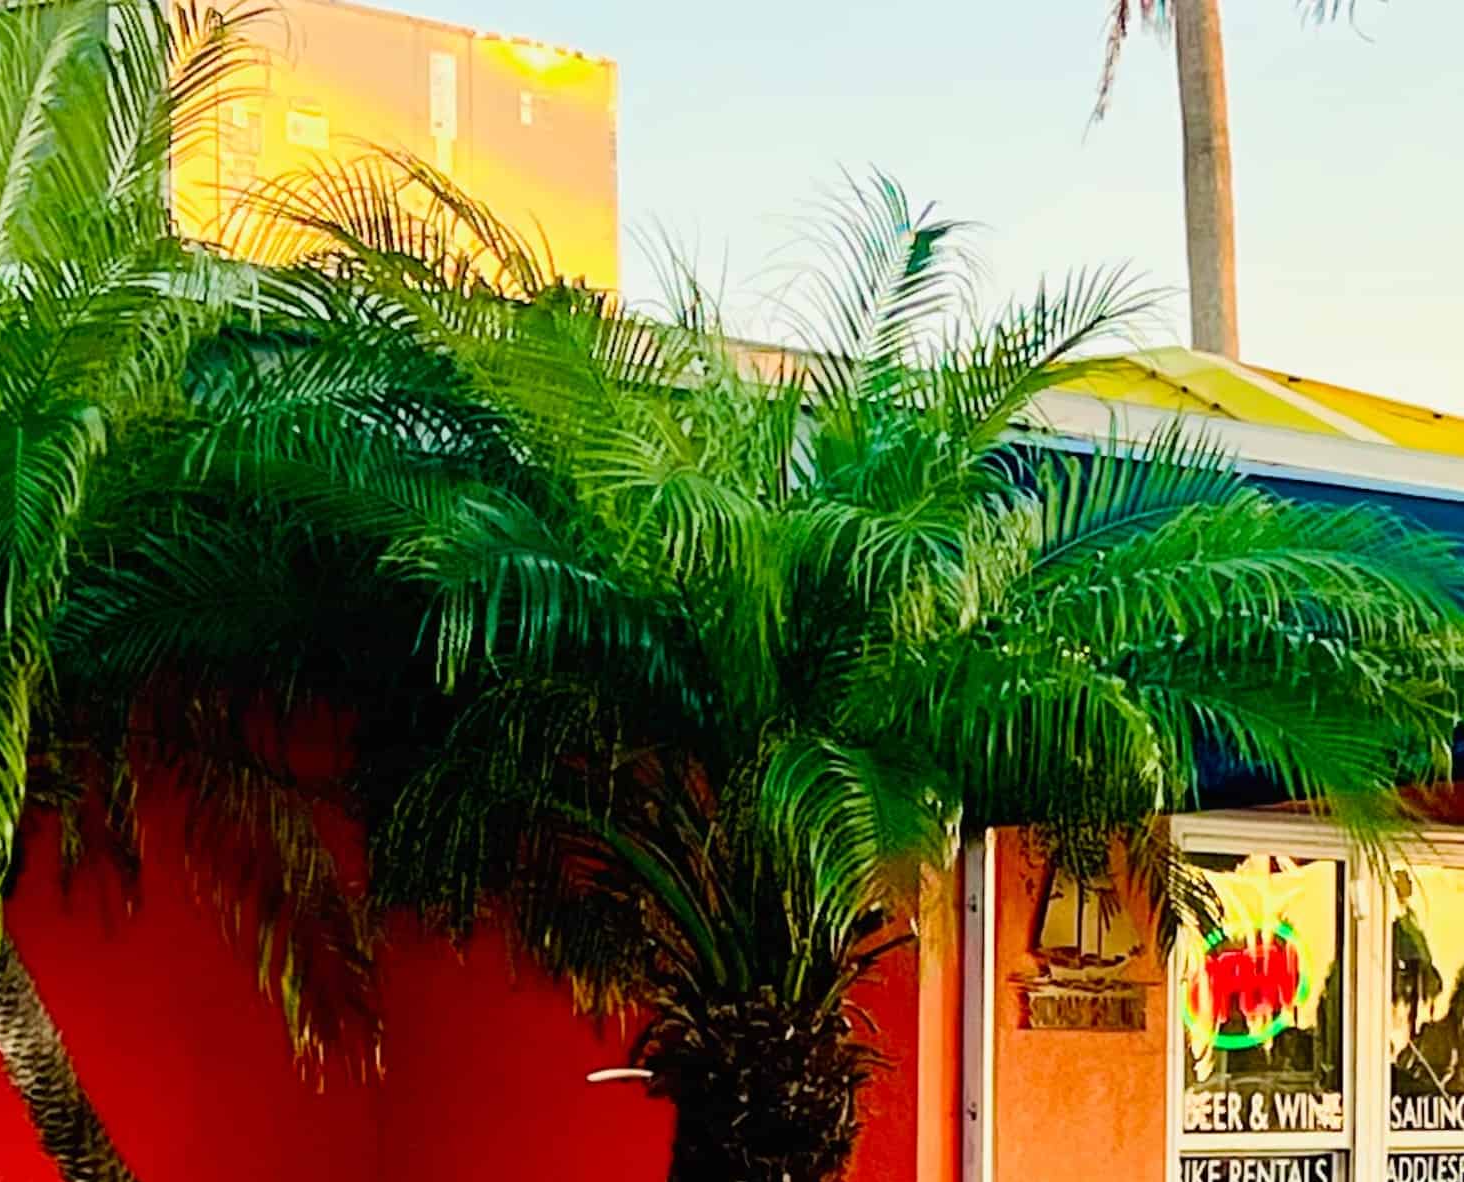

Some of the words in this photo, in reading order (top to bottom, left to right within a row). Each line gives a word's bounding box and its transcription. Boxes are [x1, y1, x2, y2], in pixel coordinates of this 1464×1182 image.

[1184, 1089, 1244, 1131] BEER
[1249, 1091, 1270, 1131] &
[1274, 1091, 1344, 1131] WINE
